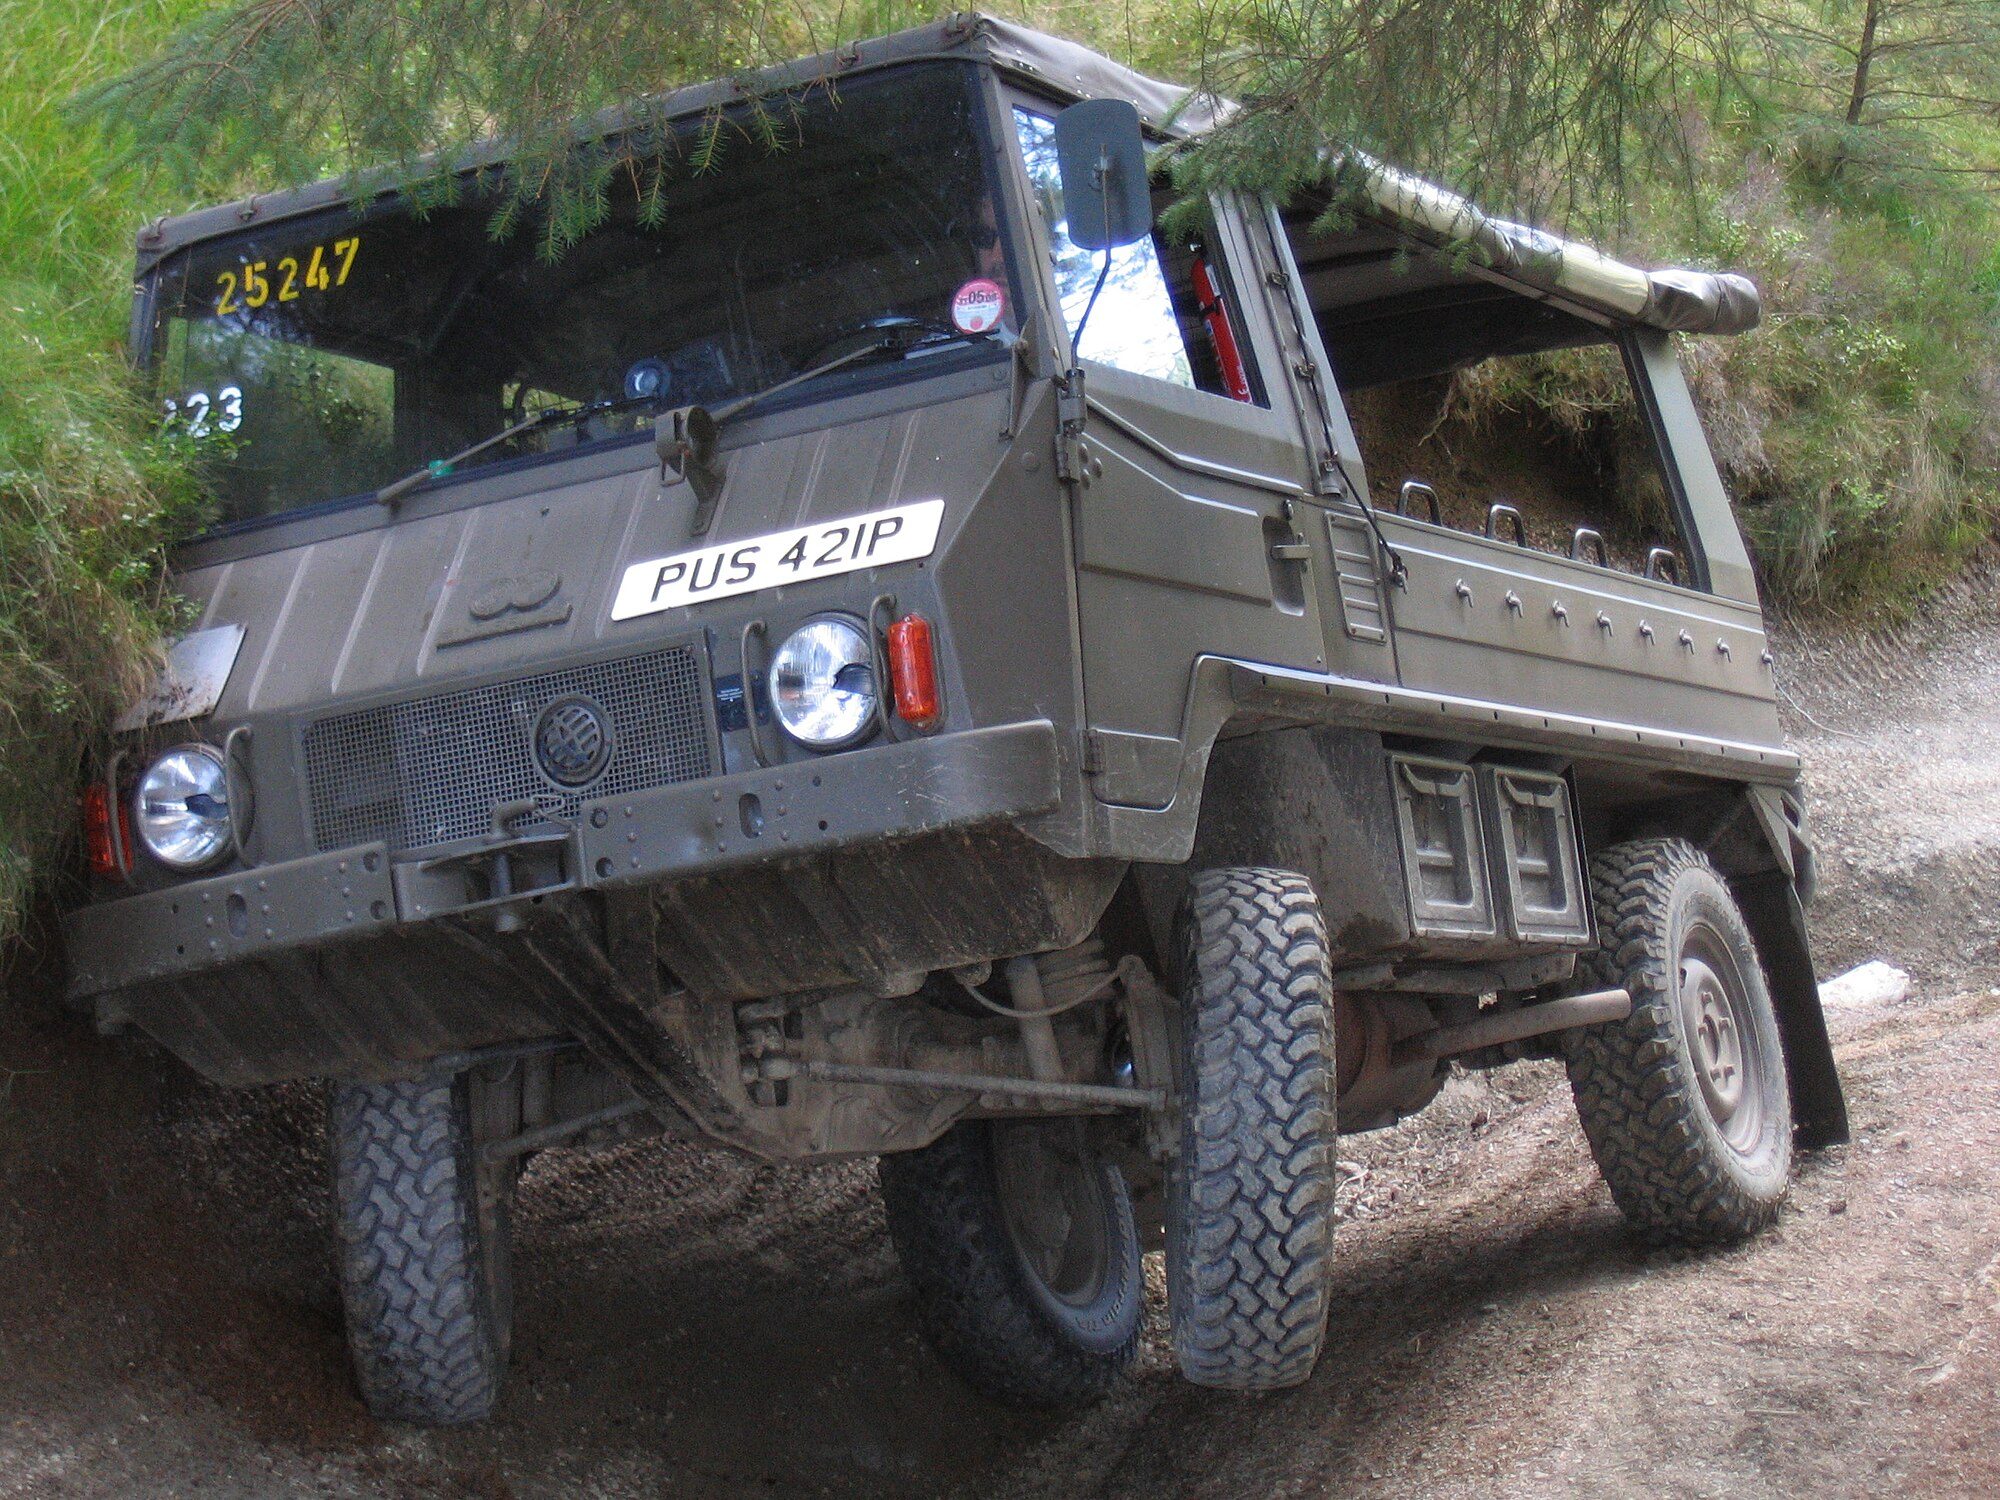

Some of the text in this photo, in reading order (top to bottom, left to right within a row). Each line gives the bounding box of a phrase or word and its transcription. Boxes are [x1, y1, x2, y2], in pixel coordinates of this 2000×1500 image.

[217, 237, 359, 316] 25247
[650, 516, 904, 603] PUS 421P
